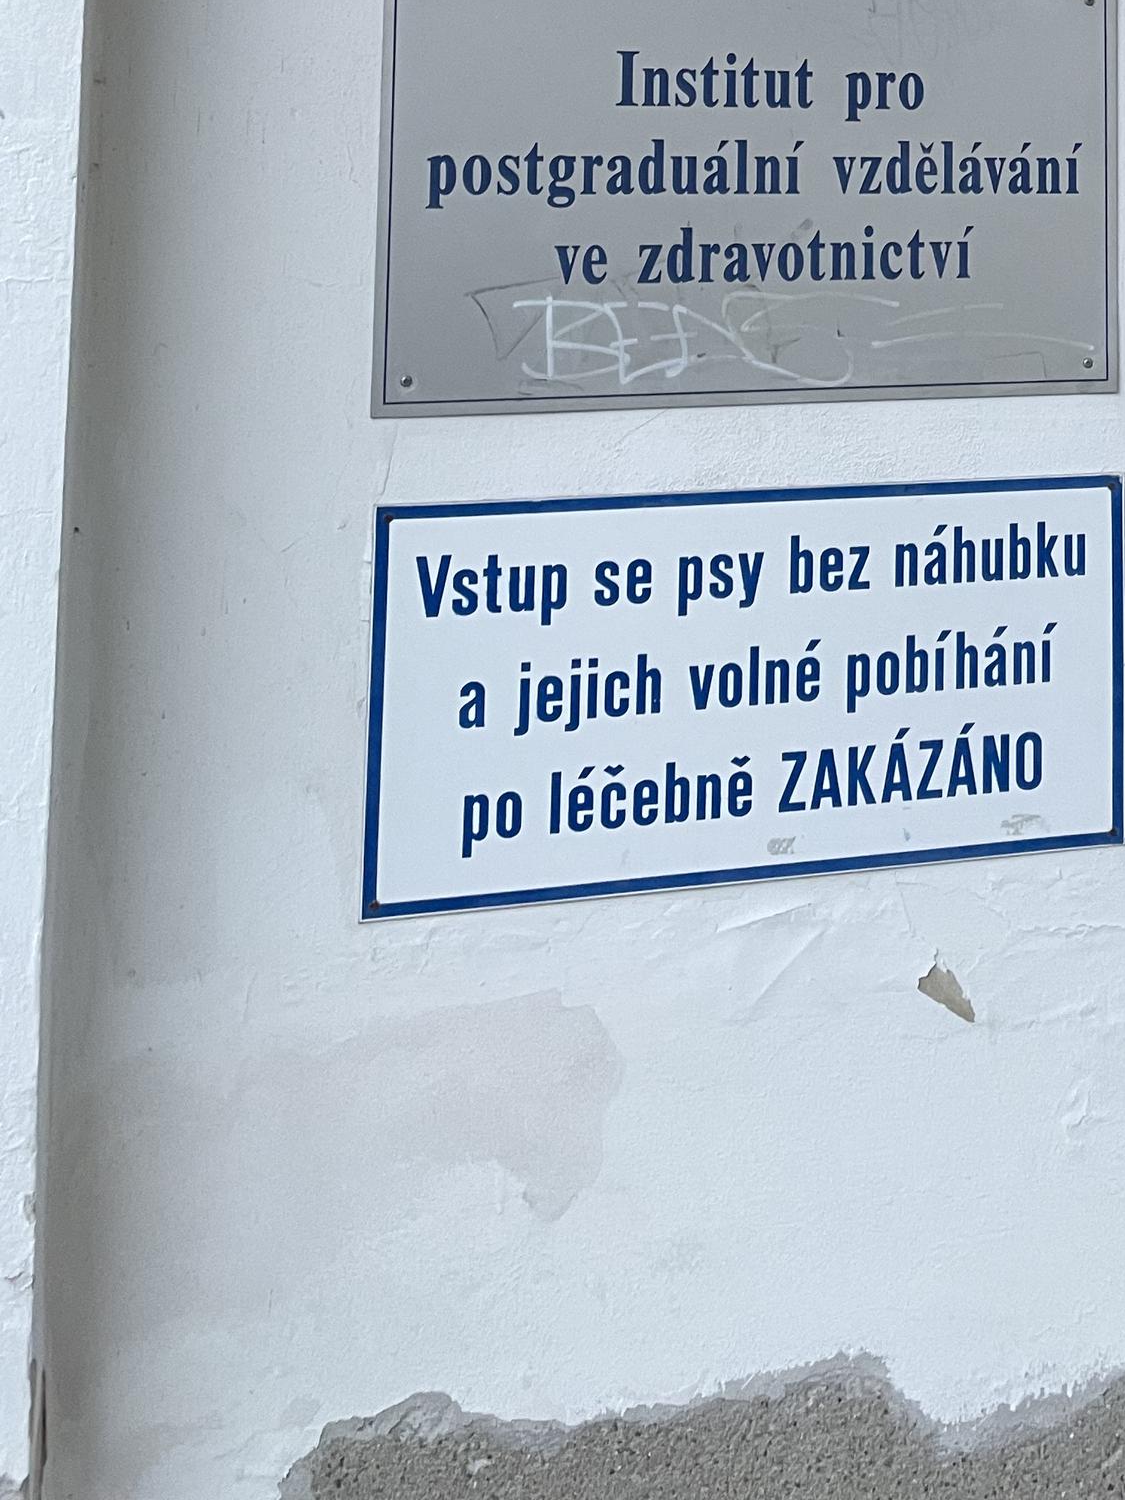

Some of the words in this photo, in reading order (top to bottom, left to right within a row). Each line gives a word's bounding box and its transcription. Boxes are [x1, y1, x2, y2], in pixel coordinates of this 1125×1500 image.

[615, 50, 814, 109] Institut
[844, 71, 925, 122] pro
[425, 138, 805, 210] postgraduální
[832, 140, 1083, 195] vzdělávání
[554, 244, 608, 285] ve
[636, 225, 975, 284] zdravotnictví
[415, 554, 568, 626] Vstup
[594, 558, 652, 607] se
[677, 551, 765, 617] psy
[789, 534, 871, 595] bez
[894, 521, 1086, 588] náhubku
[458, 681, 486, 729] a
[513, 653, 662, 737] jejich
[688, 638, 822, 711] volné
[846, 621, 1058, 714] pobíhání
[461, 791, 523, 859] po
[549, 755, 753, 835] léčebně
[778, 722, 1043, 813] ZAKÁZÁNO
